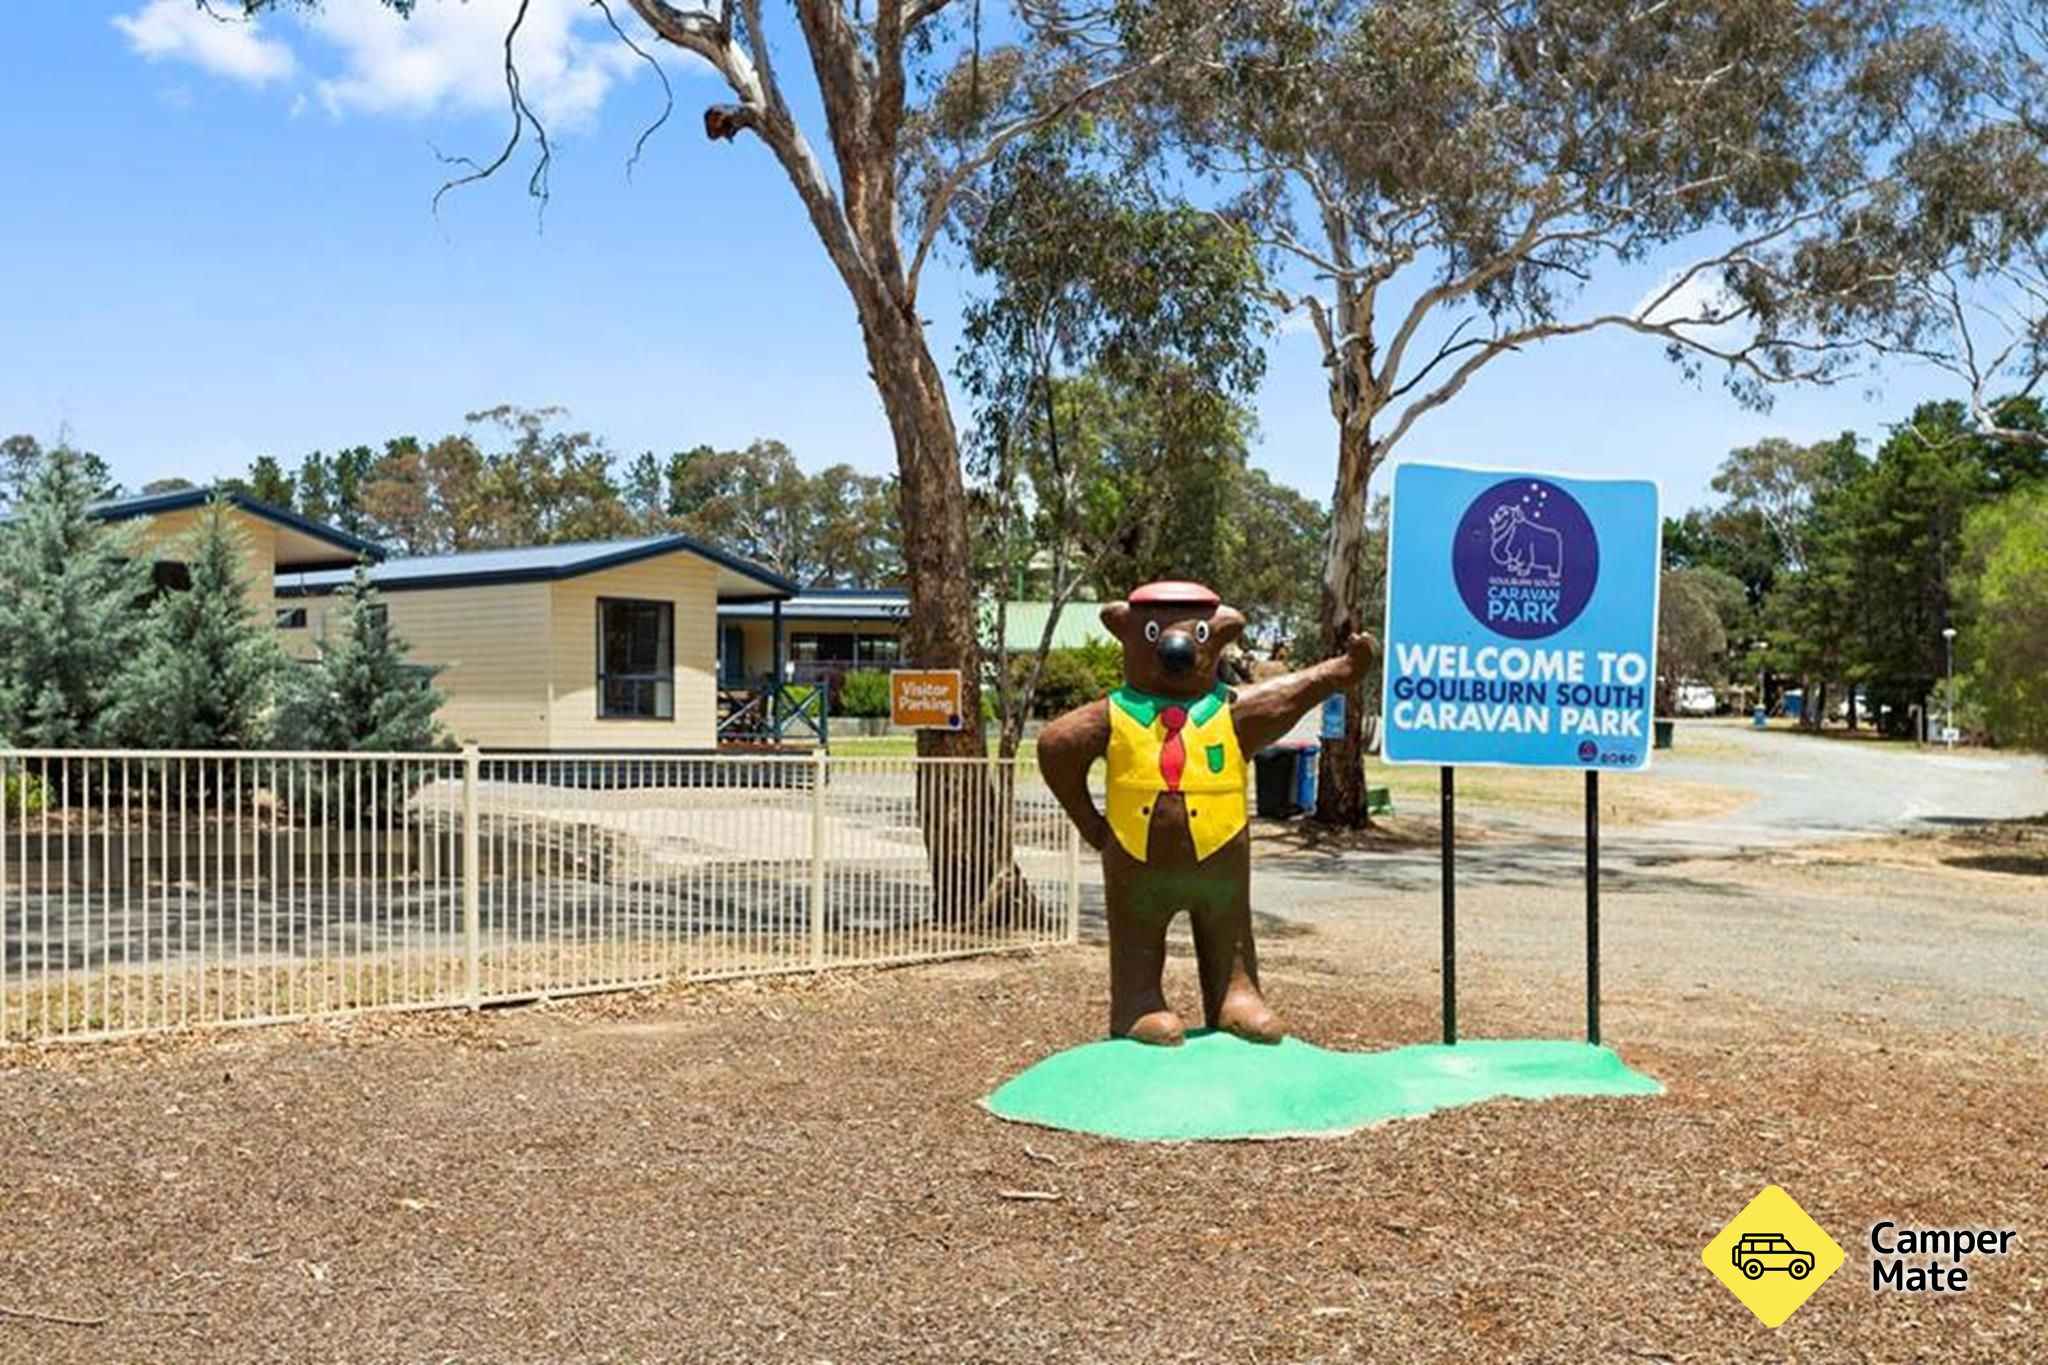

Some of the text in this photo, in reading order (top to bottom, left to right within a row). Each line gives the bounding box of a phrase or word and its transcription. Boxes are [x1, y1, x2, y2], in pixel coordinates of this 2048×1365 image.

[1487, 586, 1560, 602] CARAVAN
[1488, 600, 1558, 623] PARK
[1396, 643, 1648, 685] WELCOME TO
[901, 682, 949, 696] Visitor
[1393, 676, 1645, 709] GOULBURN SOUTH
[899, 695, 953, 714] Parking
[1393, 702, 1642, 737] CARAVAN PARK
